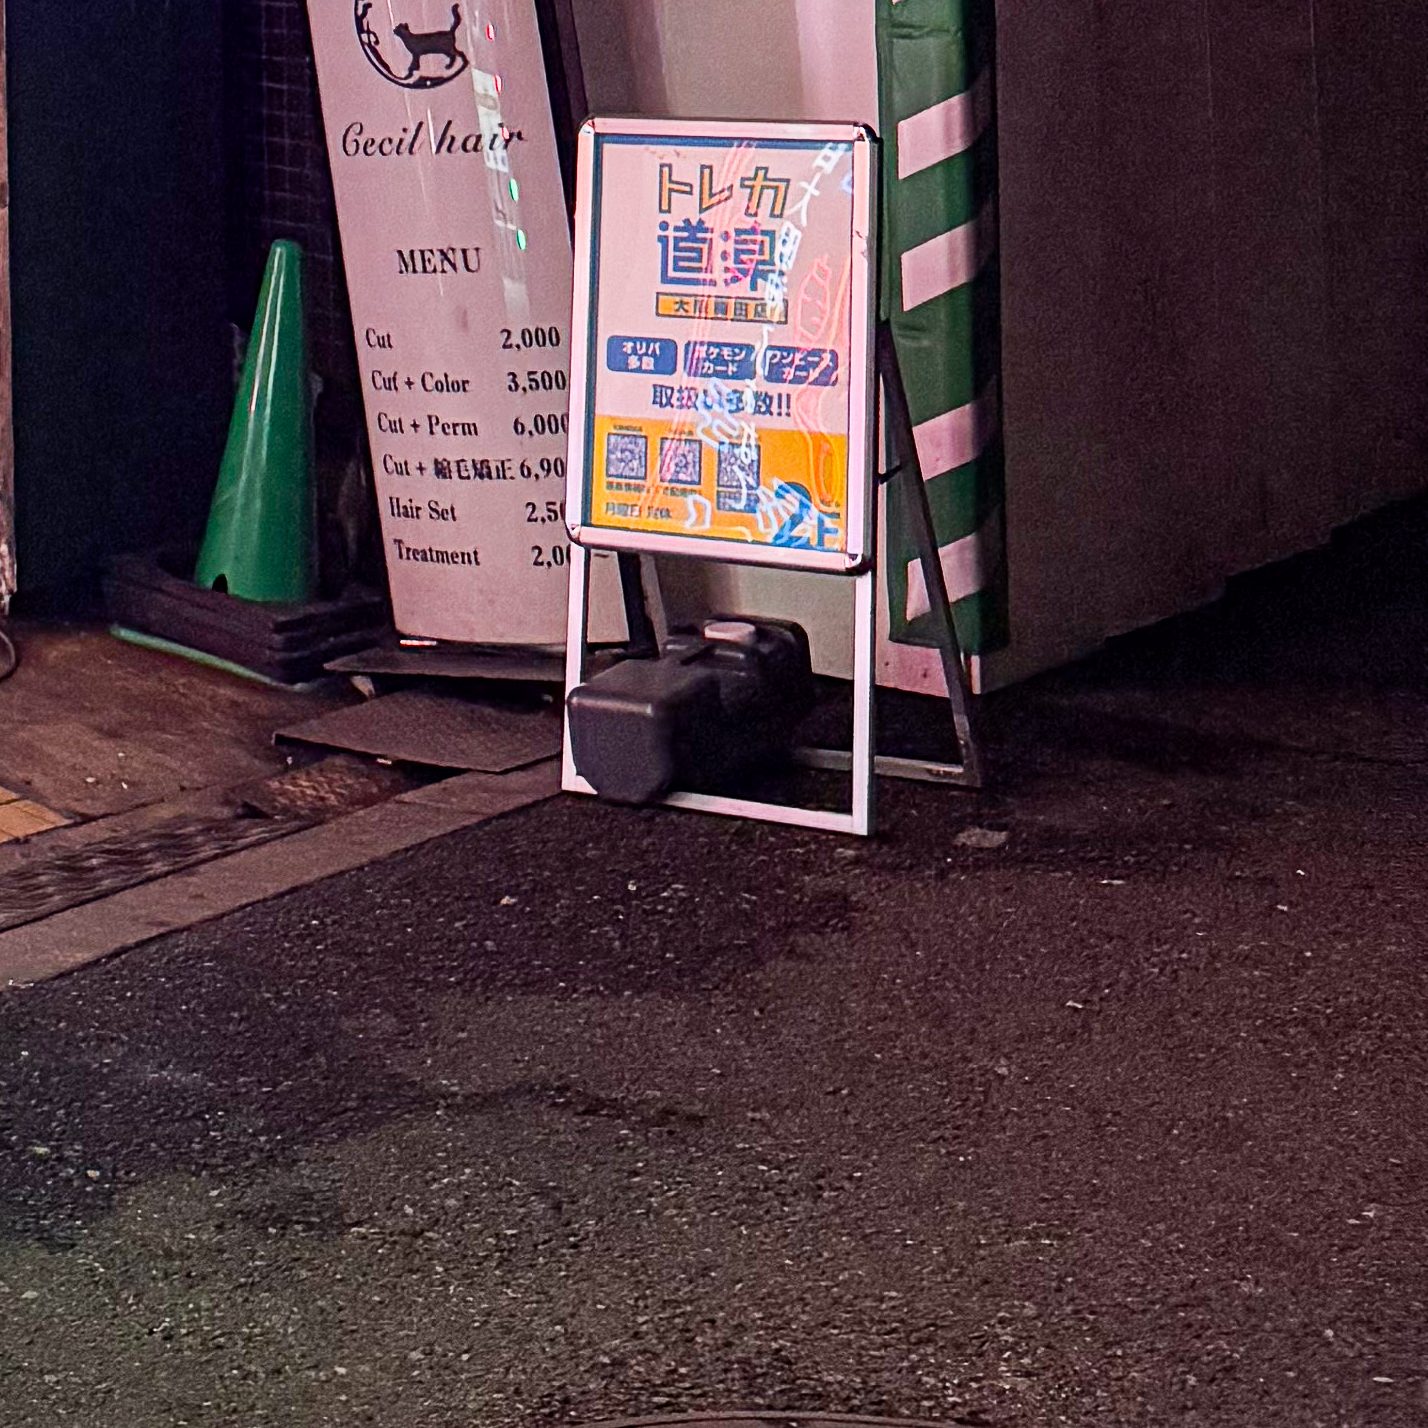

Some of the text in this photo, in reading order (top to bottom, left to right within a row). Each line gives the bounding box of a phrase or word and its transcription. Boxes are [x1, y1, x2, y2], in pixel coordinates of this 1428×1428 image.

[343, 119, 524, 156] Cecil hair
[658, 162, 791, 219] トレカ
[396, 247, 483, 275] MENU
[365, 326, 561, 351] Cut 2,000
[371, 370, 398, 393] Cut
[421, 371, 471, 394] Color
[507, 370, 567, 394] 3,500
[377, 412, 404, 435] Cut
[427, 414, 479, 437] Perm
[383, 454, 410, 477] Cut
[389, 496, 423, 520] Hair
[427, 499, 458, 522] Set
[393, 538, 481, 567] Treatment
